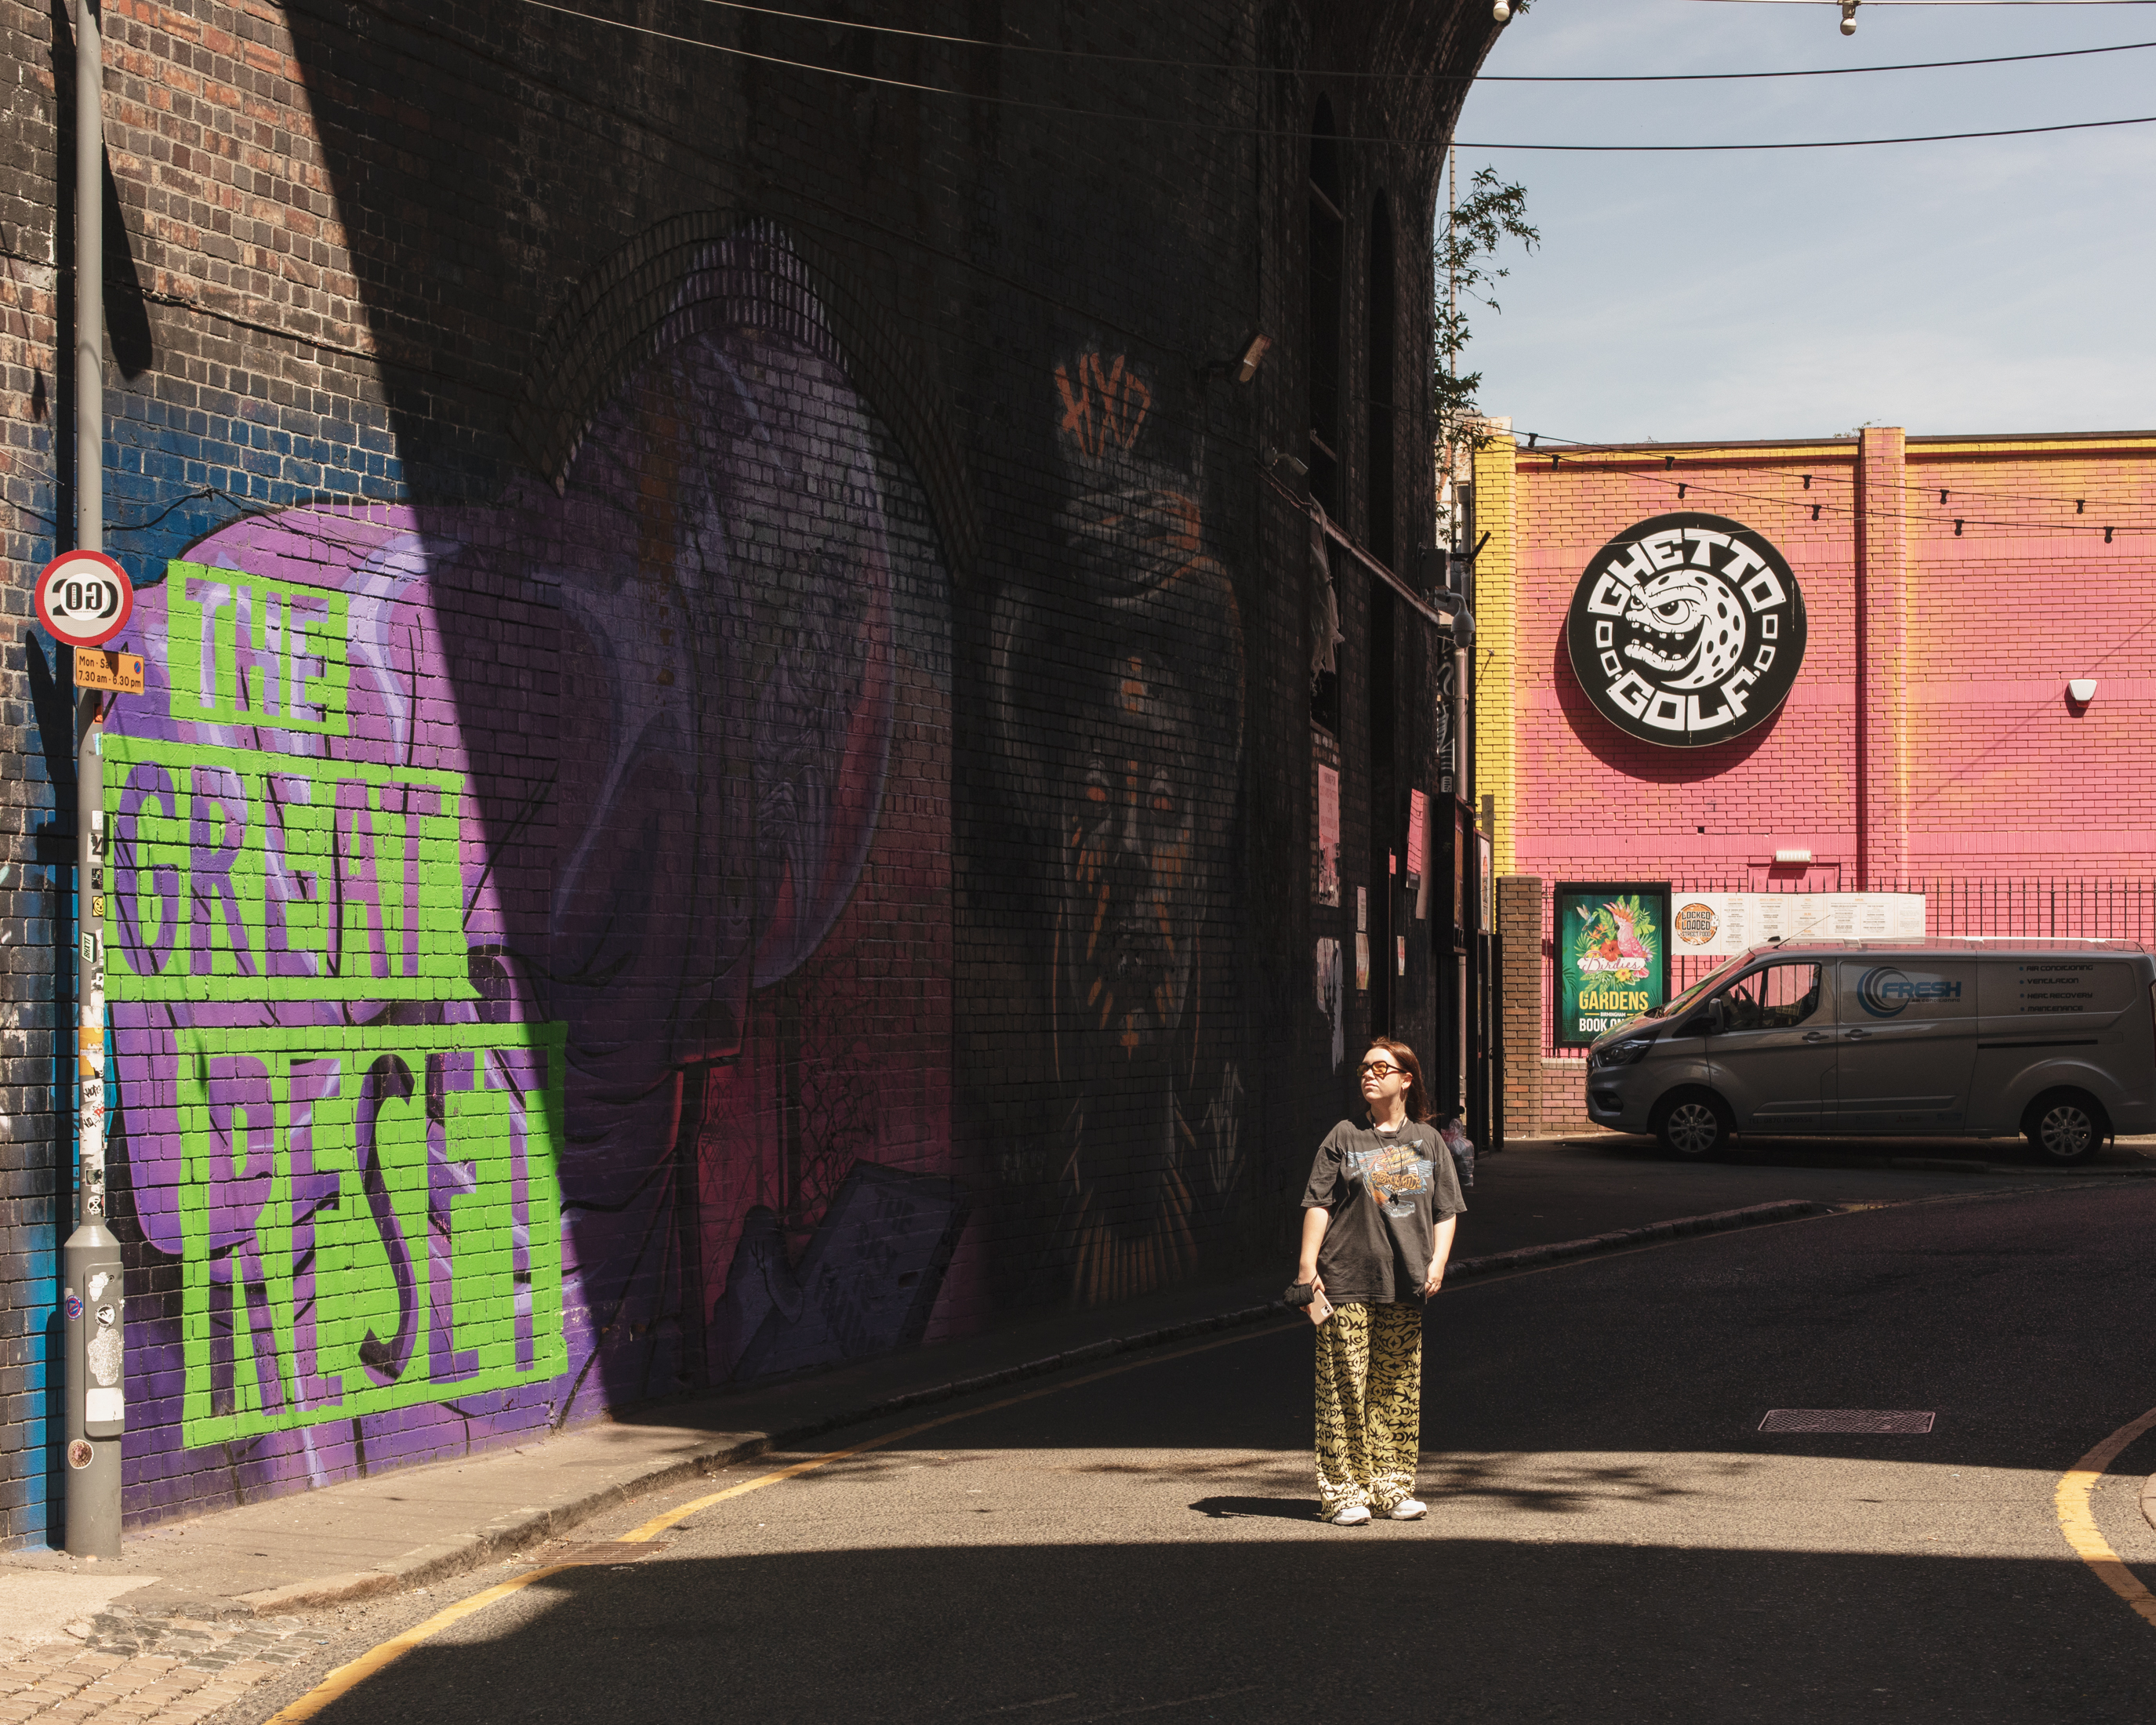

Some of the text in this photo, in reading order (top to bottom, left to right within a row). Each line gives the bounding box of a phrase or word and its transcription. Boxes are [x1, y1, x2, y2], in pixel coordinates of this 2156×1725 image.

[1587, 528, 1787, 616] GHETTO
[184, 576, 329, 723] THE
[79, 656, 95, 667] Mon
[100, 659, 113, 670] Sat
[78, 670, 96, 681] 7.30
[96, 674, 107, 684] am
[113, 675, 129, 686] 6.30
[131, 678, 141, 688] pm
[1606, 666, 1749, 732] GOLF
[114, 761, 441, 978] GREAT
[1682, 911, 1711, 920] LOCKED
[1682, 920, 1711, 931] LOADED
[1582, 950, 1641, 975] Birdies
[1882, 981, 1962, 998] FRESH
[1579, 990, 1649, 1011] GARDENS
[1579, 1018, 1608, 1032] BOOK
[209, 1049, 550, 1417] RESET
